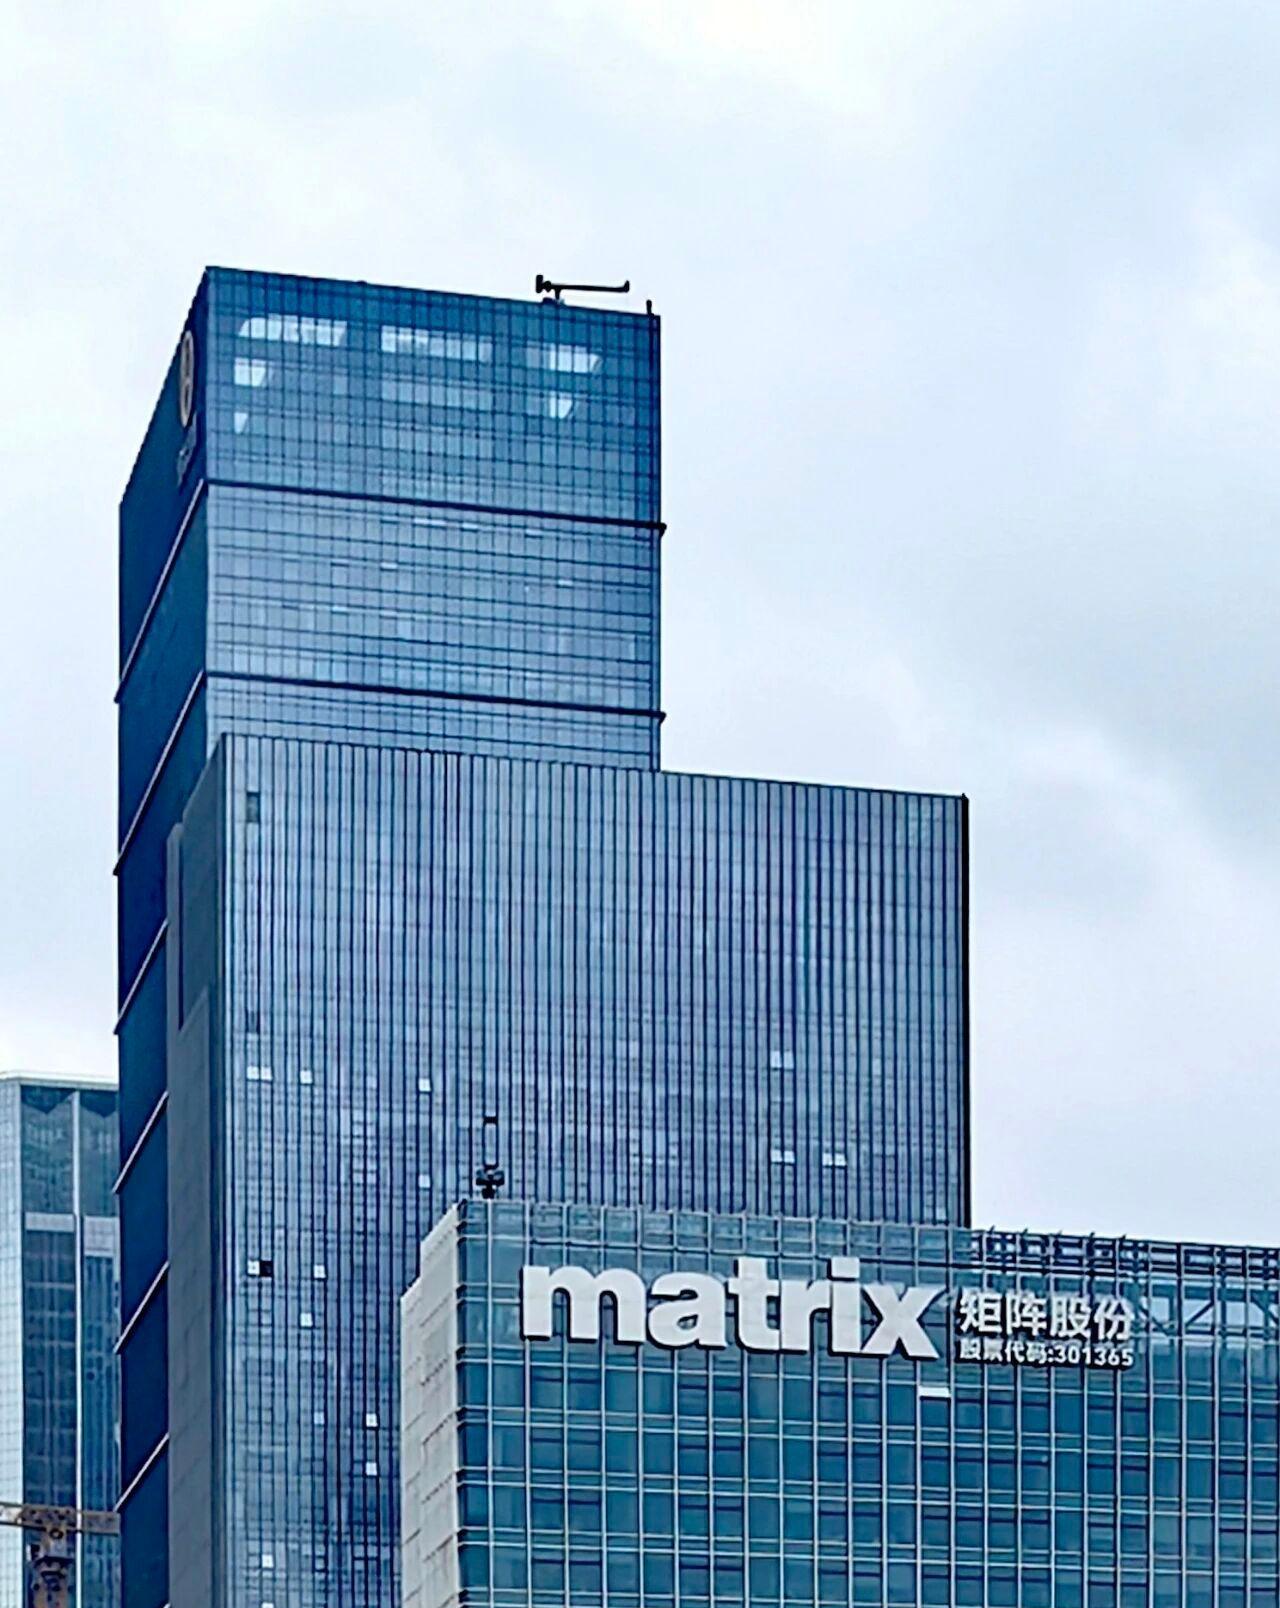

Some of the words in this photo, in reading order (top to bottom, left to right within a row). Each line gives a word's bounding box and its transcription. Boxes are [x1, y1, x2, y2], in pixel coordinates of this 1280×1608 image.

[522, 1256, 944, 1359] matrix
[959, 1286, 1135, 1340] 矩阵股份
